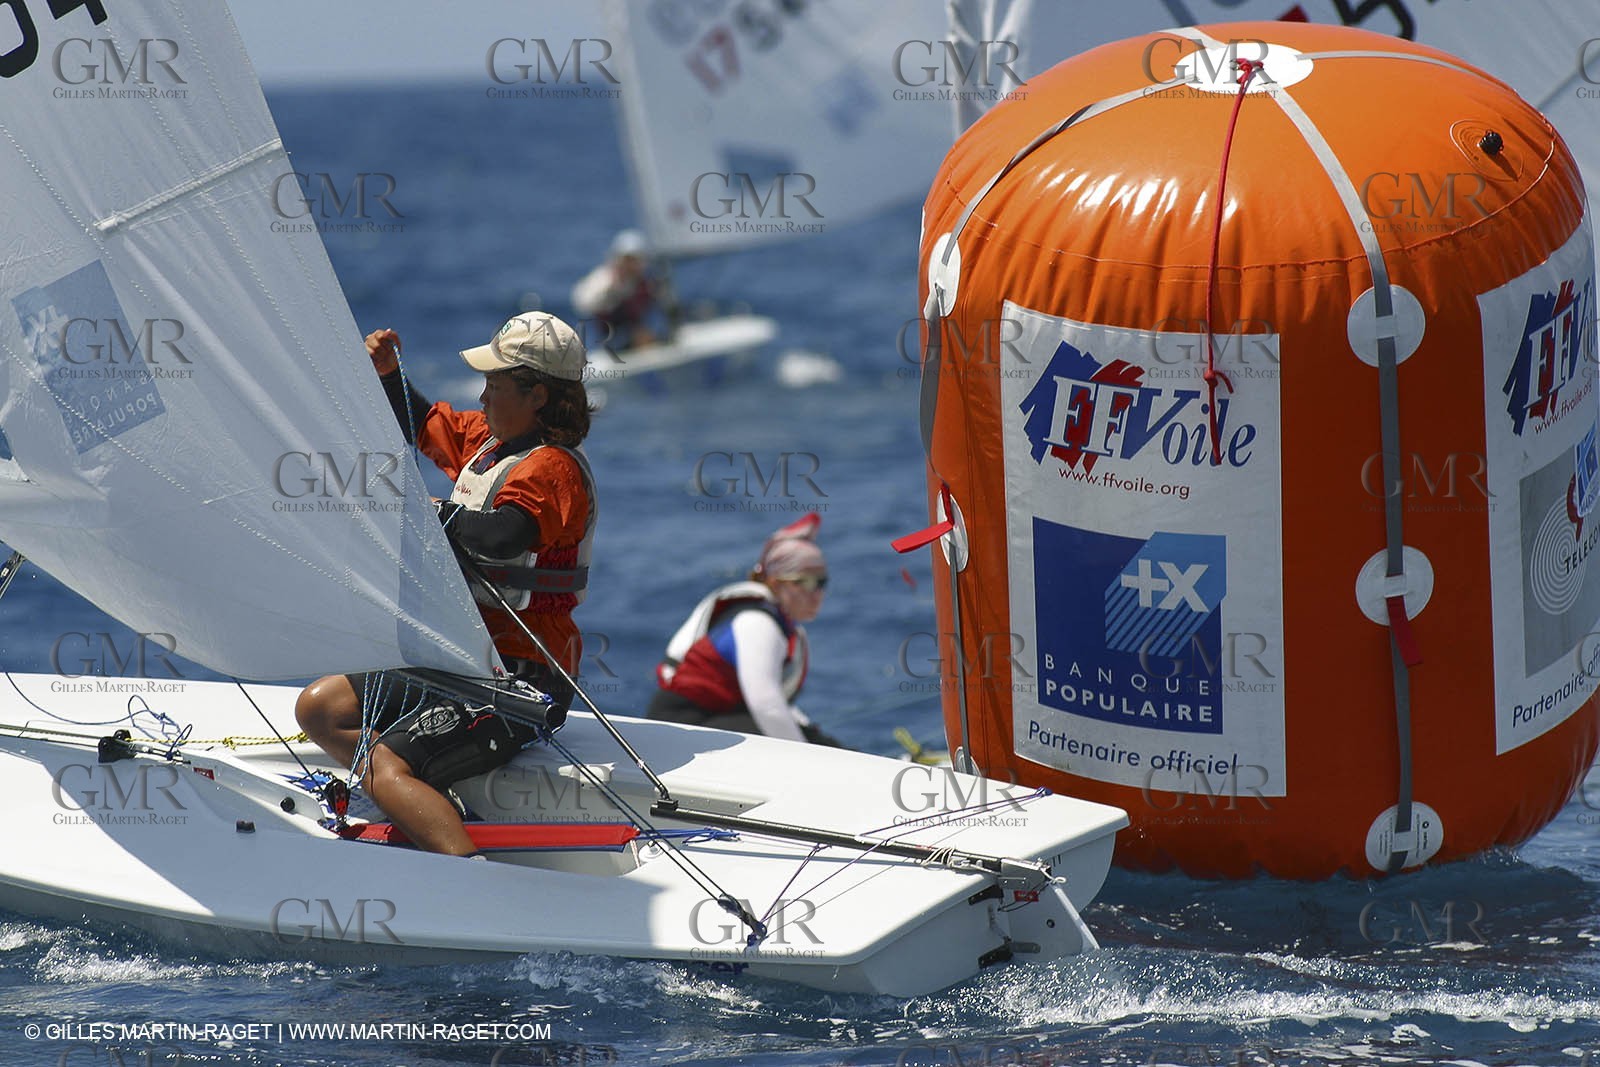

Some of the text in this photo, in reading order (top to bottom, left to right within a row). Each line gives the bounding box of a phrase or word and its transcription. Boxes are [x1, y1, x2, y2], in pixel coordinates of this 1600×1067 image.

[1043, 375, 1256, 468] FFVoile
[1058, 467, 1191, 500] www.ffvoile.org
[1564, 523, 1600, 575] TELECO
[1044, 653, 1210, 696] BANQUE
[1512, 670, 1584, 729] Partenaire
[1045, 679, 1213, 723] POPULAIRE
[1028, 719, 1238, 775] Partenaire officiel
